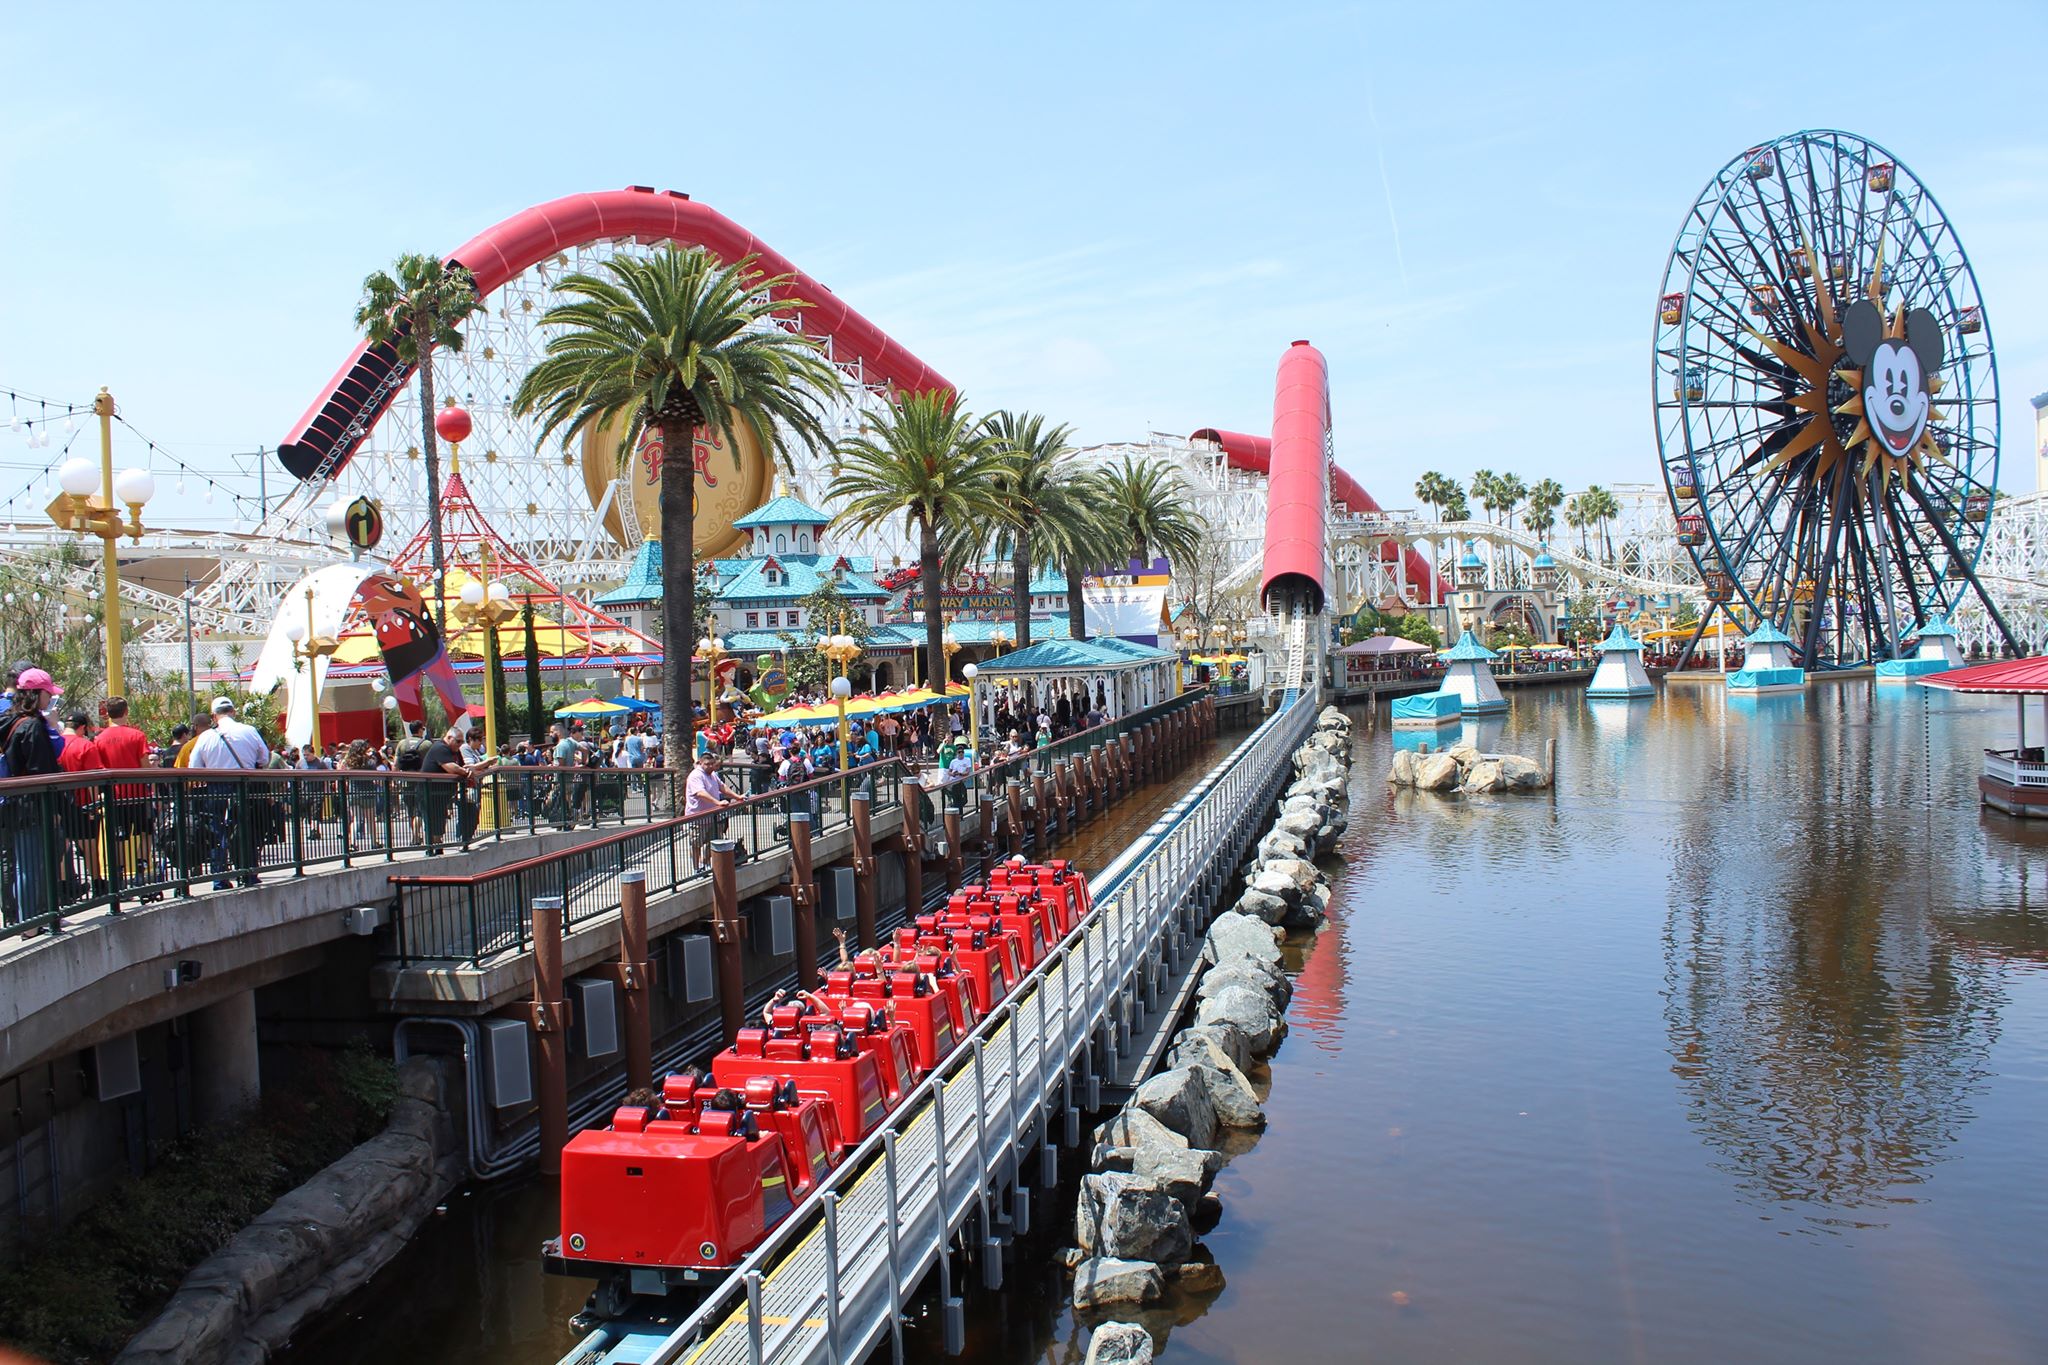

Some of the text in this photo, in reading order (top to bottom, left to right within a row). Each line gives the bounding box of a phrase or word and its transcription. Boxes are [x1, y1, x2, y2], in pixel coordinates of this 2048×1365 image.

[642, 440, 718, 488] PR
[912, 597, 964, 609] MWAY
[574, 1238, 581, 1247] 4
[704, 1246, 711, 1255] 4
